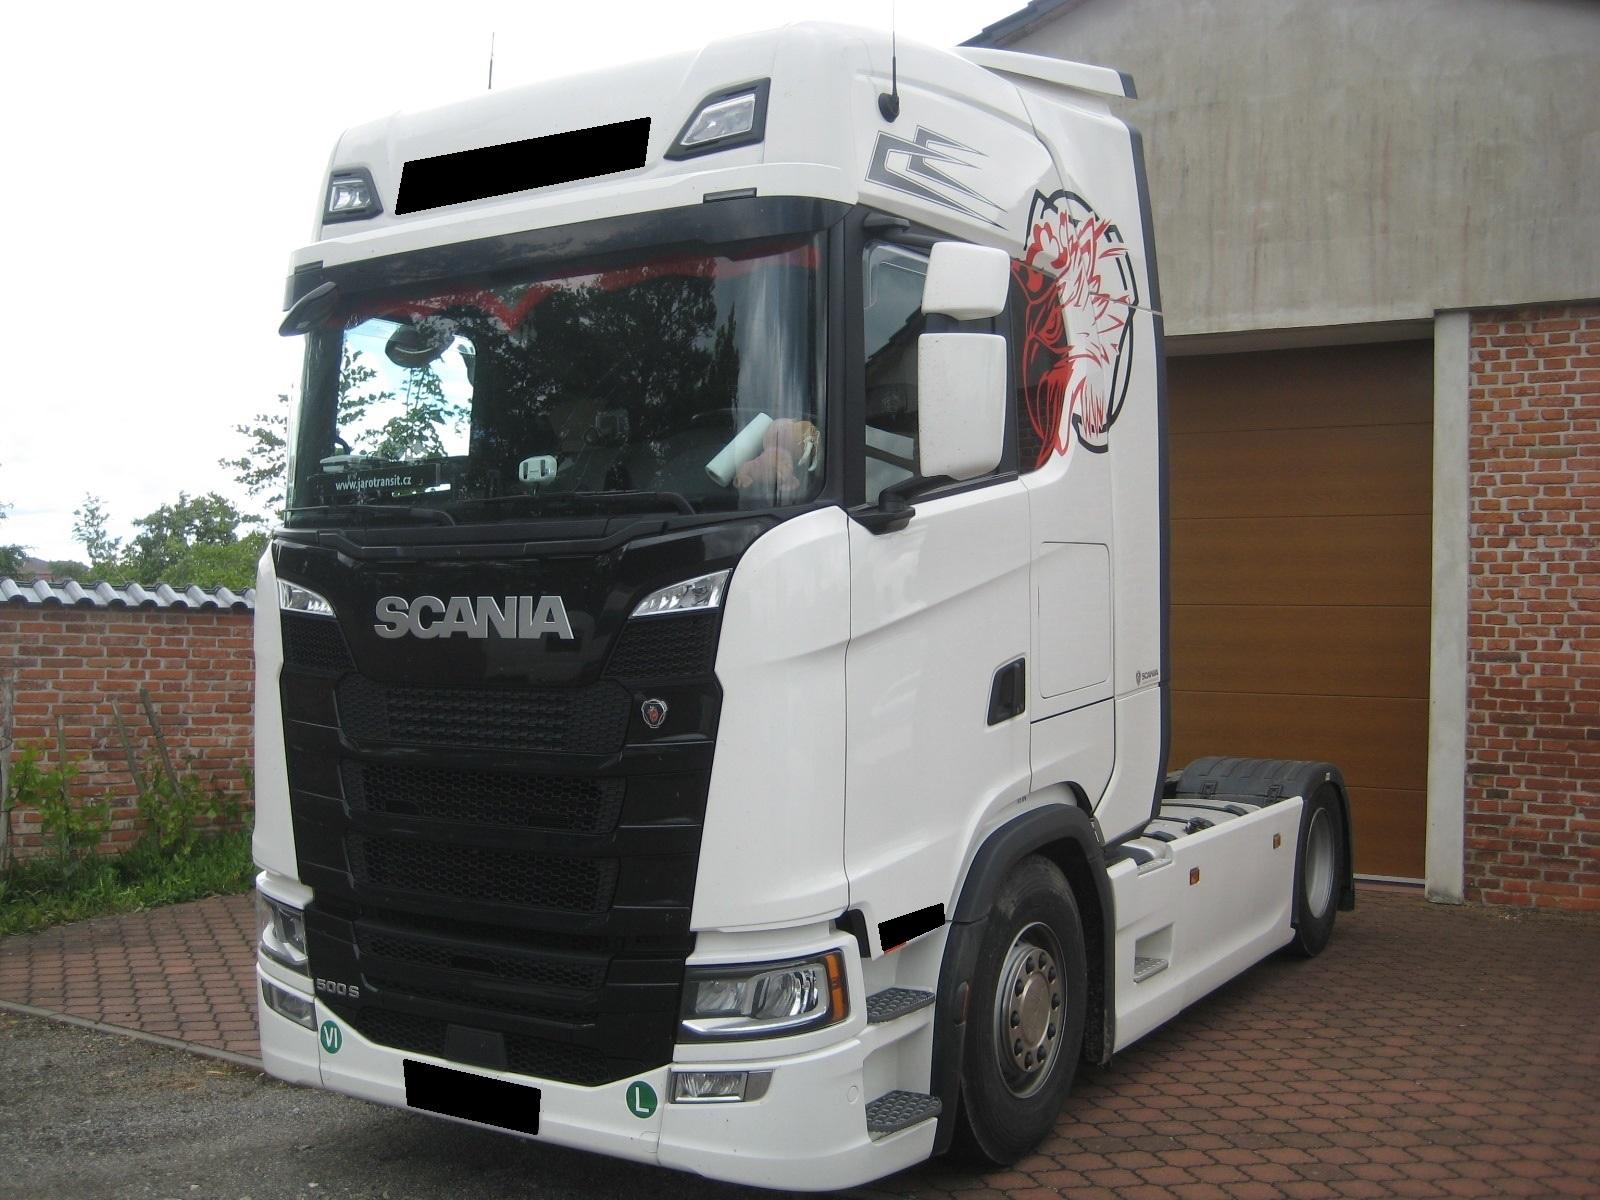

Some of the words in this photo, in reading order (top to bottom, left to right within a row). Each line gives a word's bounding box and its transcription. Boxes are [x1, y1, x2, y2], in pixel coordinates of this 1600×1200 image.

[335, 474, 412, 492] www.jarotransit.cz
[374, 595, 575, 639] SCANIA
[316, 977, 347, 996] 500
[348, 985, 360, 999] S
[323, 1025, 338, 1049] VI
[635, 1086, 650, 1113] L
